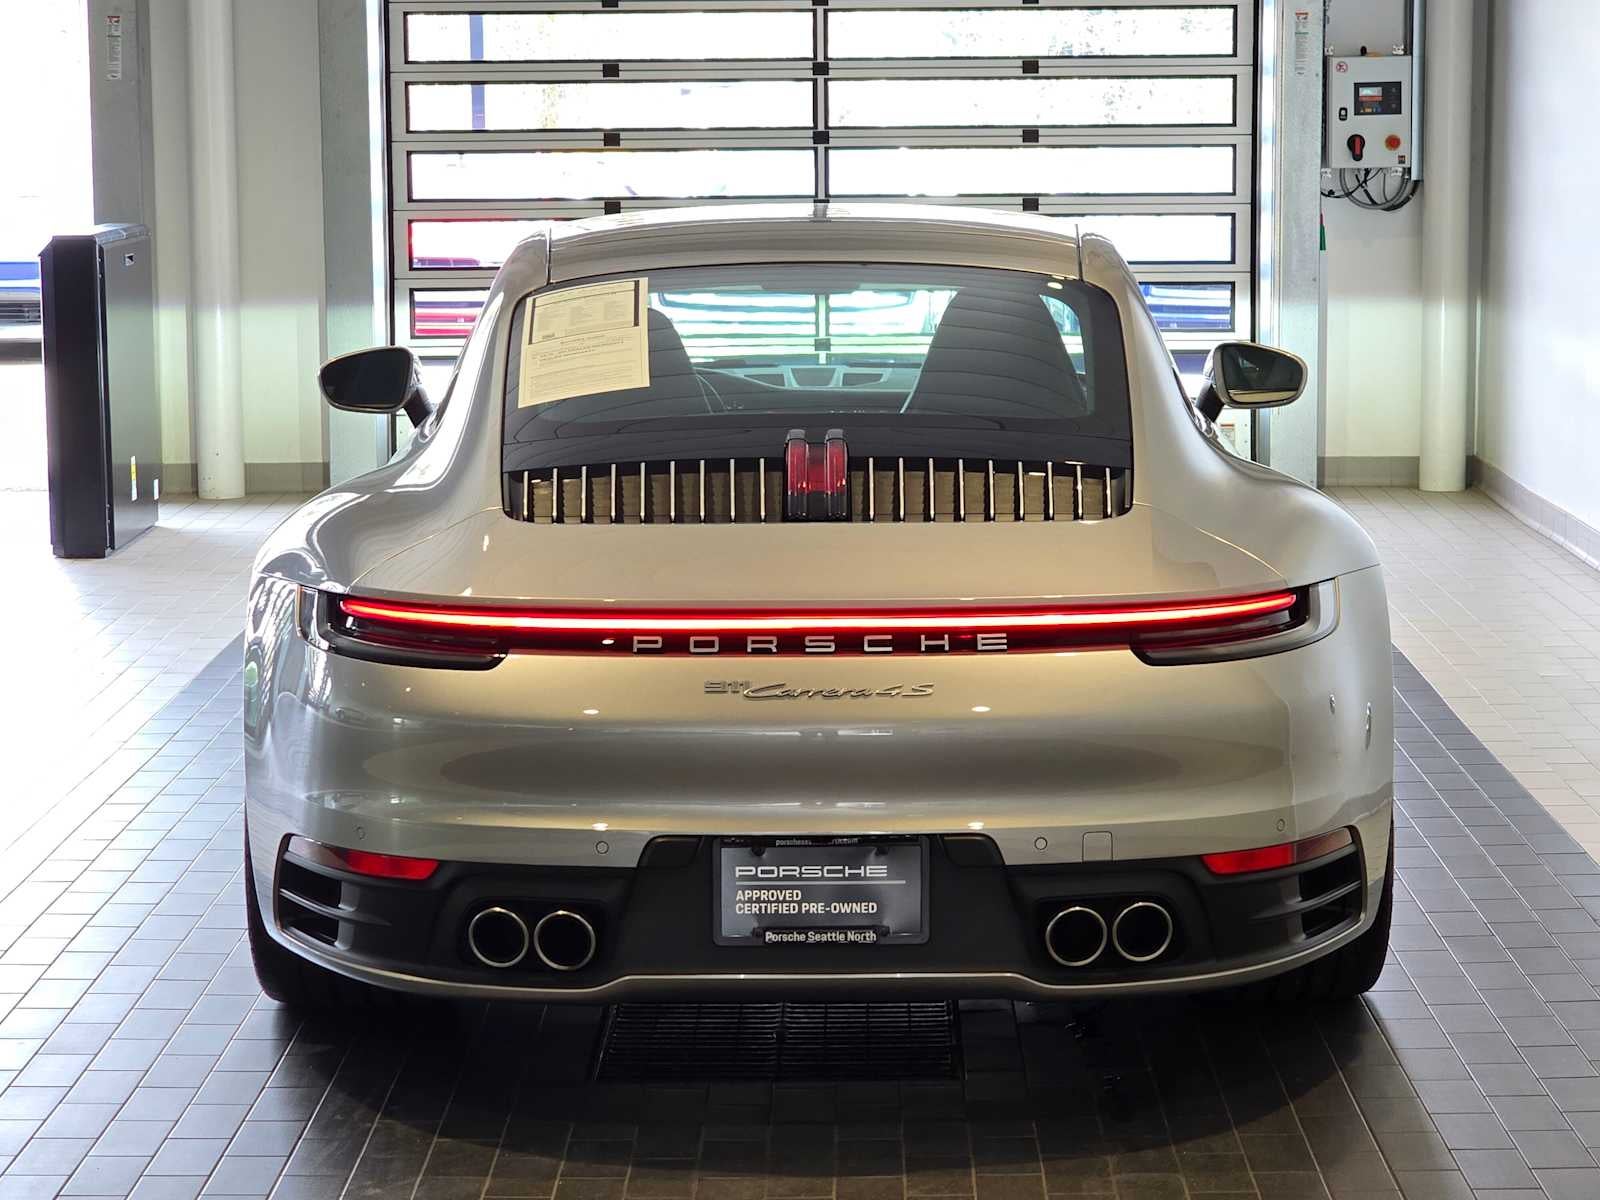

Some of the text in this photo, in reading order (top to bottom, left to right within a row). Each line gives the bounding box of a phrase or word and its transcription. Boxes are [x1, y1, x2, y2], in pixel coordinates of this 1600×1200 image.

[632, 633, 1008, 654] PORSCHE
[704, 680, 750, 695] 911
[743, 682, 874, 701] Carrera
[735, 865, 888, 878] PORSCHE
[735, 889, 802, 901] APPROVED
[735, 903, 878, 915] CERTIFIED PRE-OWNED
[765, 931, 877, 942] Porsche Seattle North
